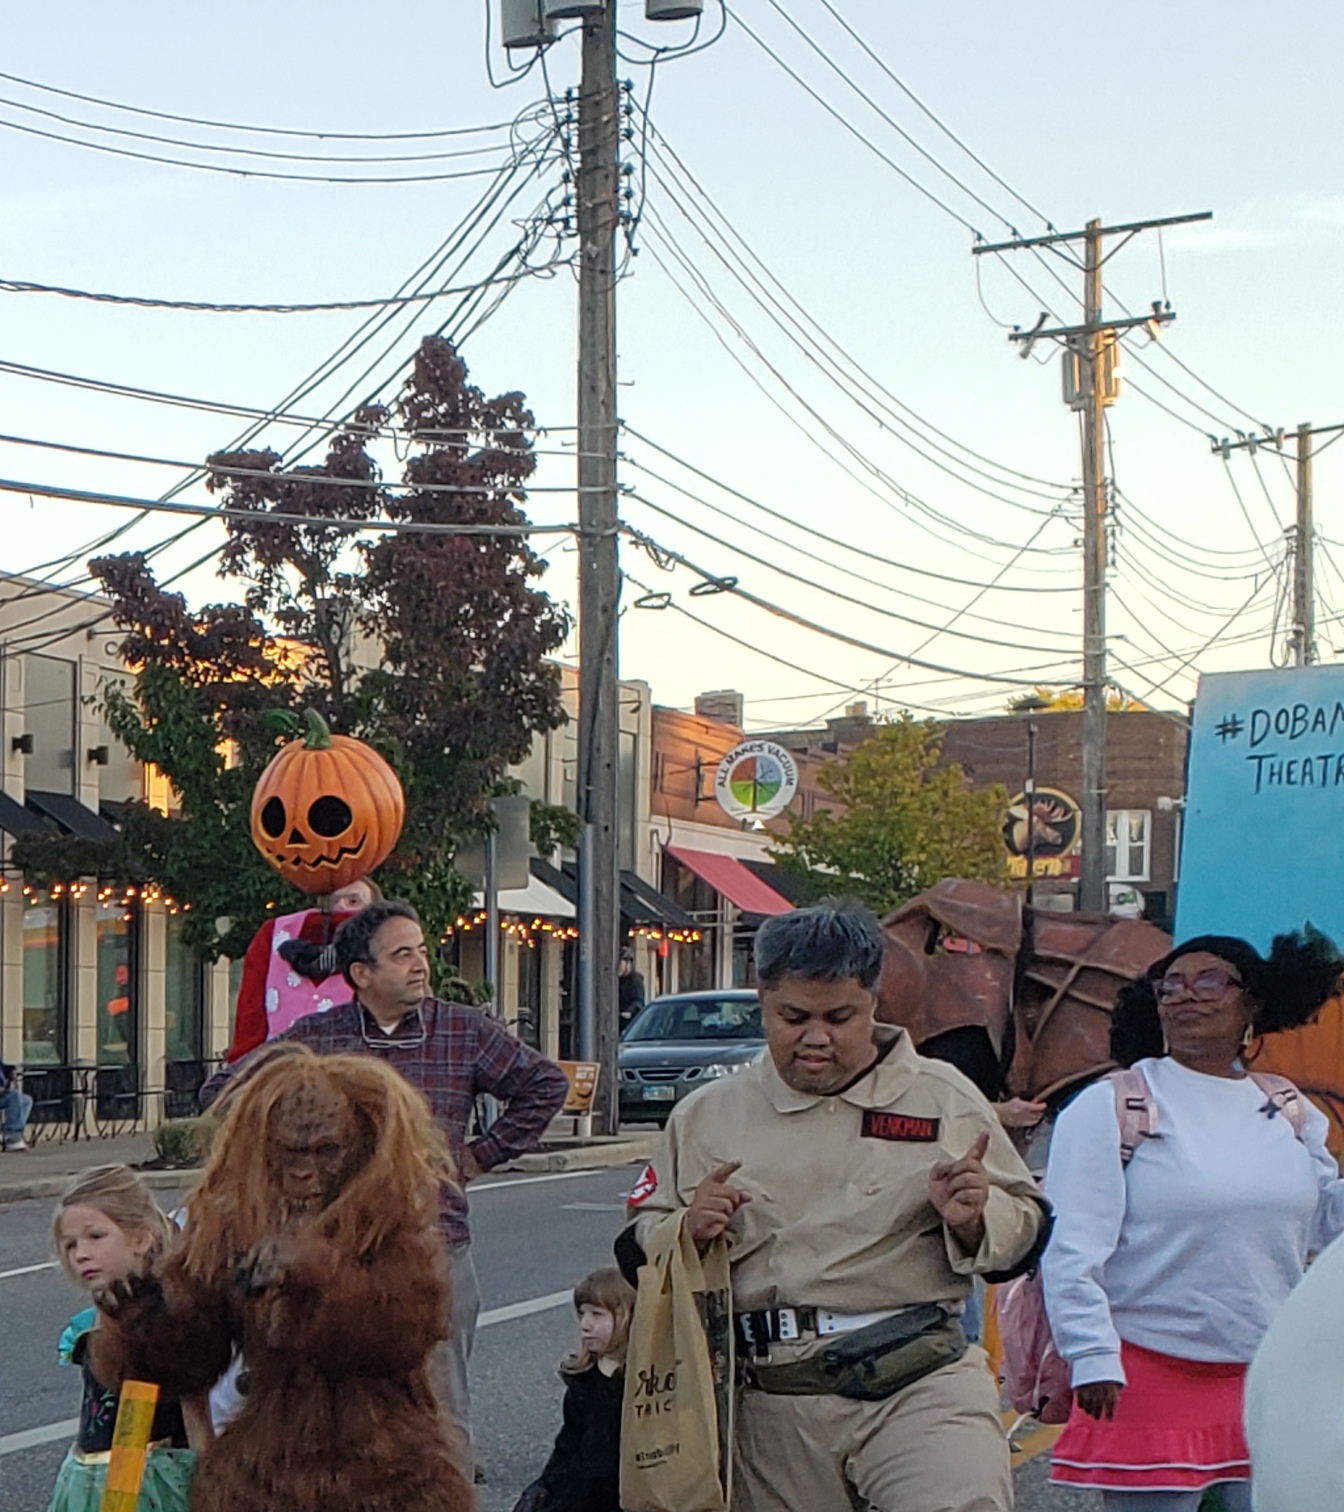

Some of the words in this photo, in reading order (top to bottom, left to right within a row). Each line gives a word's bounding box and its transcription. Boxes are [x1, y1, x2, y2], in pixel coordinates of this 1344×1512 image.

[717, 766, 730, 788] ALL
[725, 743, 765, 767] MAKES
[767, 744, 795, 787] VACUUM
